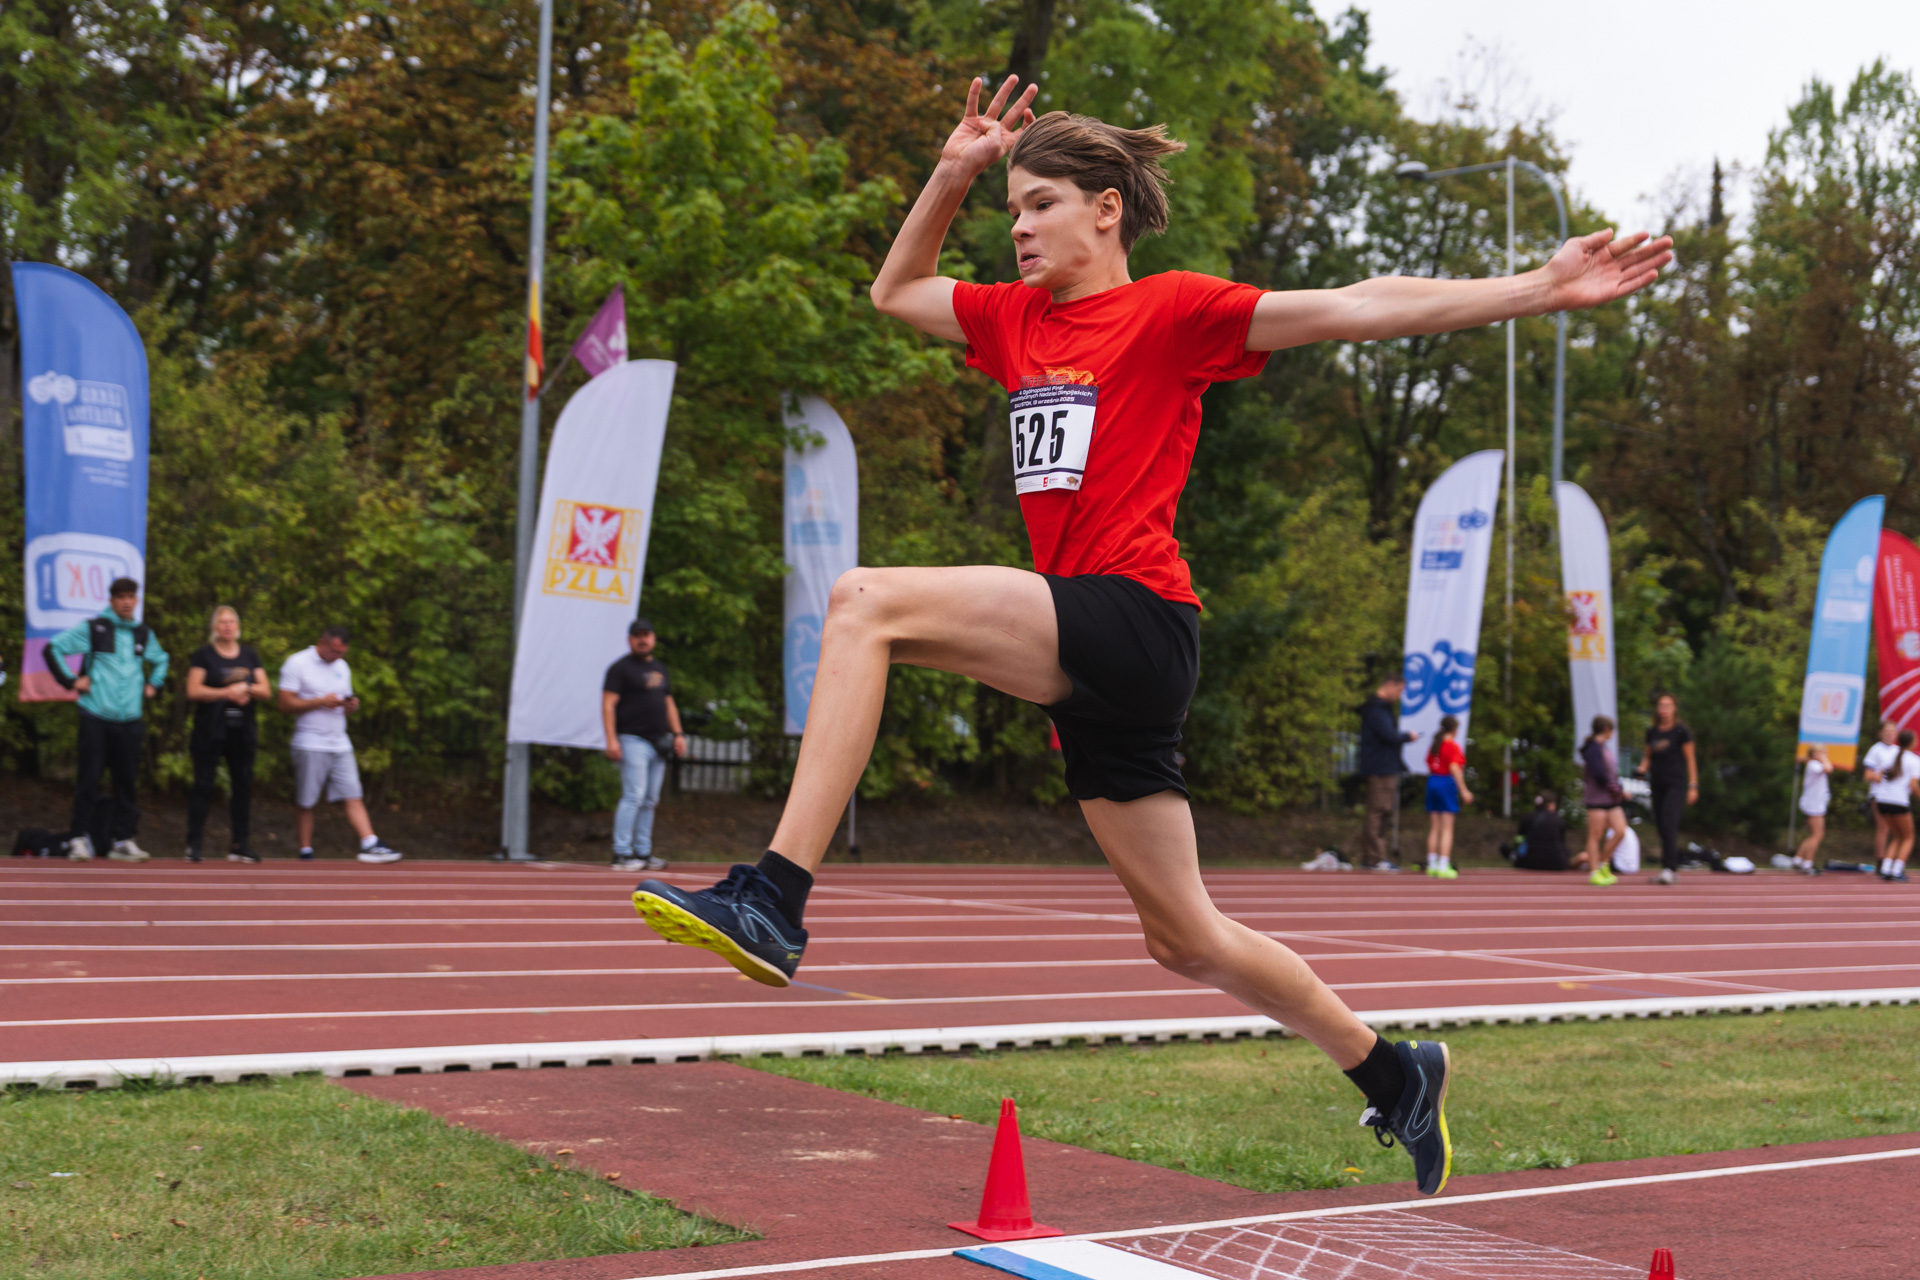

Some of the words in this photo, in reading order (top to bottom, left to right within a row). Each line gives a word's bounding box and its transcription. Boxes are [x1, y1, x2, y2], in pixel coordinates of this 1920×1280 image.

[1058, 389, 1093, 398] Olimpijskich
[1015, 410, 1069, 470] 525
[549, 564, 624, 597] PZLA
